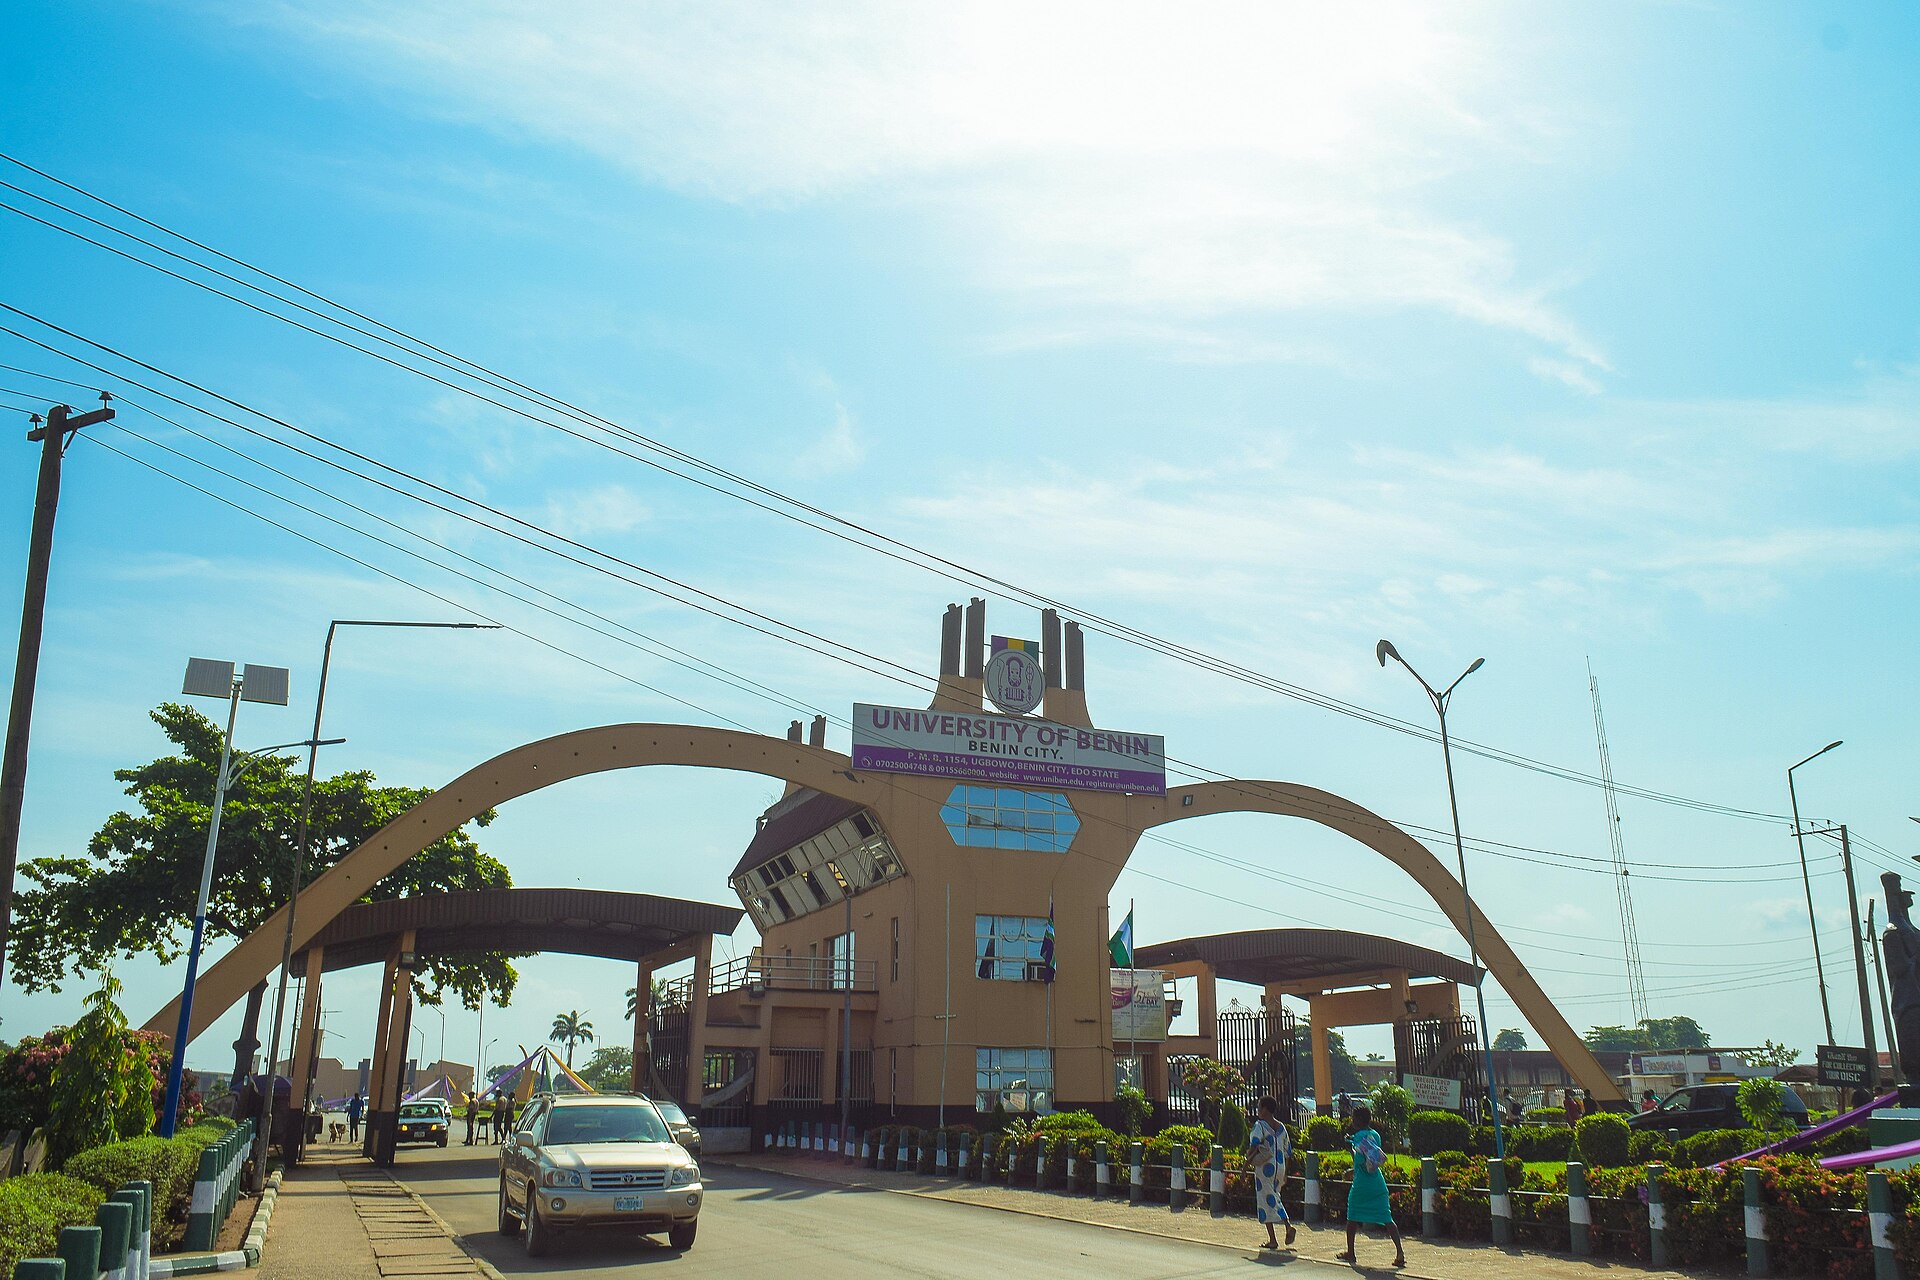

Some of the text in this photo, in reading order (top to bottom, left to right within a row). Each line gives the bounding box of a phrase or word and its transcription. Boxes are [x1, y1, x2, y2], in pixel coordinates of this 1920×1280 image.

[872, 708, 1150, 756] UNIVERSITY OF BENIN
[968, 740, 1064, 760] BENIN CITY.
[875, 759, 927, 772] 07025004748
[989, 771, 1019, 781] website:
[1085, 781, 1160, 793] registrar@uniben.edu
[944, 756, 969, 766] 1154,
[1046, 765, 1070, 776] CITY,
[1071, 767, 1090, 777] EDO
[1092, 769, 1120, 780] STATE
[1821, 1060, 1866, 1072] FOR COLLECTING
[1825, 1070, 1860, 1082] YOUR DISC
[1415, 1083, 1448, 1091] VEHICLES
